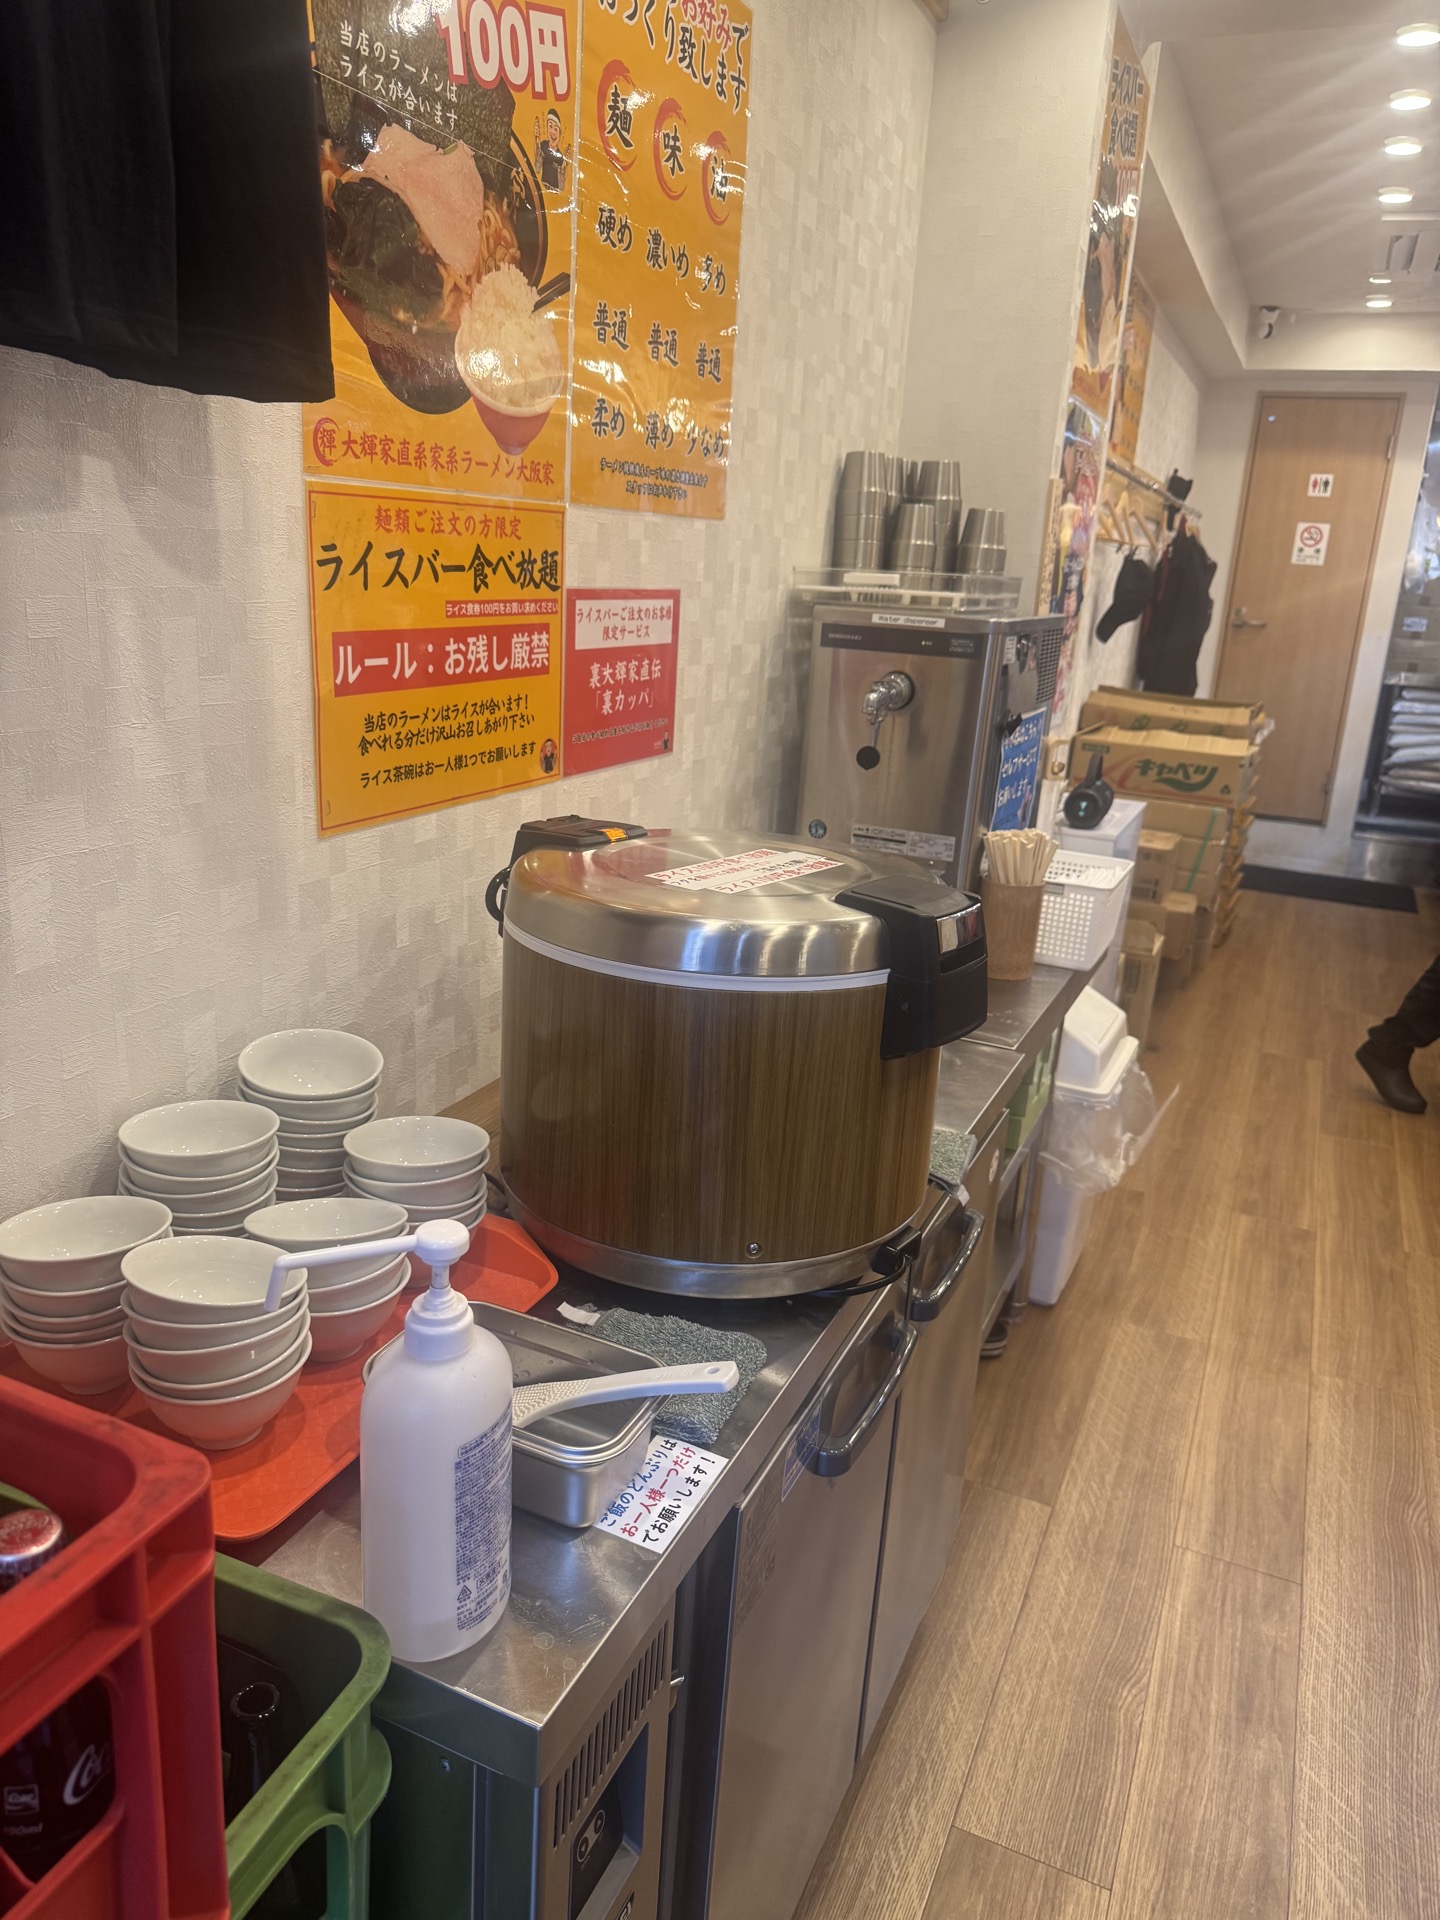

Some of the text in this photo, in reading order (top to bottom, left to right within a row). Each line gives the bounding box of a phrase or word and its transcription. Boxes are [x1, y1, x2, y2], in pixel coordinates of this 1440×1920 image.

[340, 20, 458, 104] 当店のラーメンは
[437, 0, 571, 100] 100円
[340, 55, 458, 132] ライスが合います
[605, 84, 635, 148] 麺
[662, 125, 685, 177] 味
[597, 206, 633, 252] 硬め
[646, 227, 690, 279] 濃いめ
[592, 302, 722, 384] 普通 普通 普通
[591, 398, 626, 438] 柔め
[645, 411, 675, 450] 薄め
[341, 430, 555, 487] 大輝家直系家系ラーメン大阪家
[375, 505, 522, 541] 麺類ご注文の方限定
[316, 541, 561, 594] ライスバー食べ放題
[445, 602, 558, 617] ライス食券100円をお買い求めください
[577, 605, 672, 625] ライスバーご注文のお客様
[602, 625, 651, 642] 限定サービス
[335, 631, 550, 686] ルール：お残し厳禁
[589, 658, 662, 689] 裏大輝家直伝
[358, 713, 535, 756] 食べれる分だけ沢山お召しあがり下さい
[364, 694, 529, 733] 当店のラーメンはライスが合います！
[360, 741, 537, 789] ライス茶碗はお一人様1つでお願いします
[1134, 758, 1218, 792] キャベツ
[600, 1439, 678, 1527] ご飯のどんぶりは
[621, 1446, 696, 1537] お一人様一つだけ
